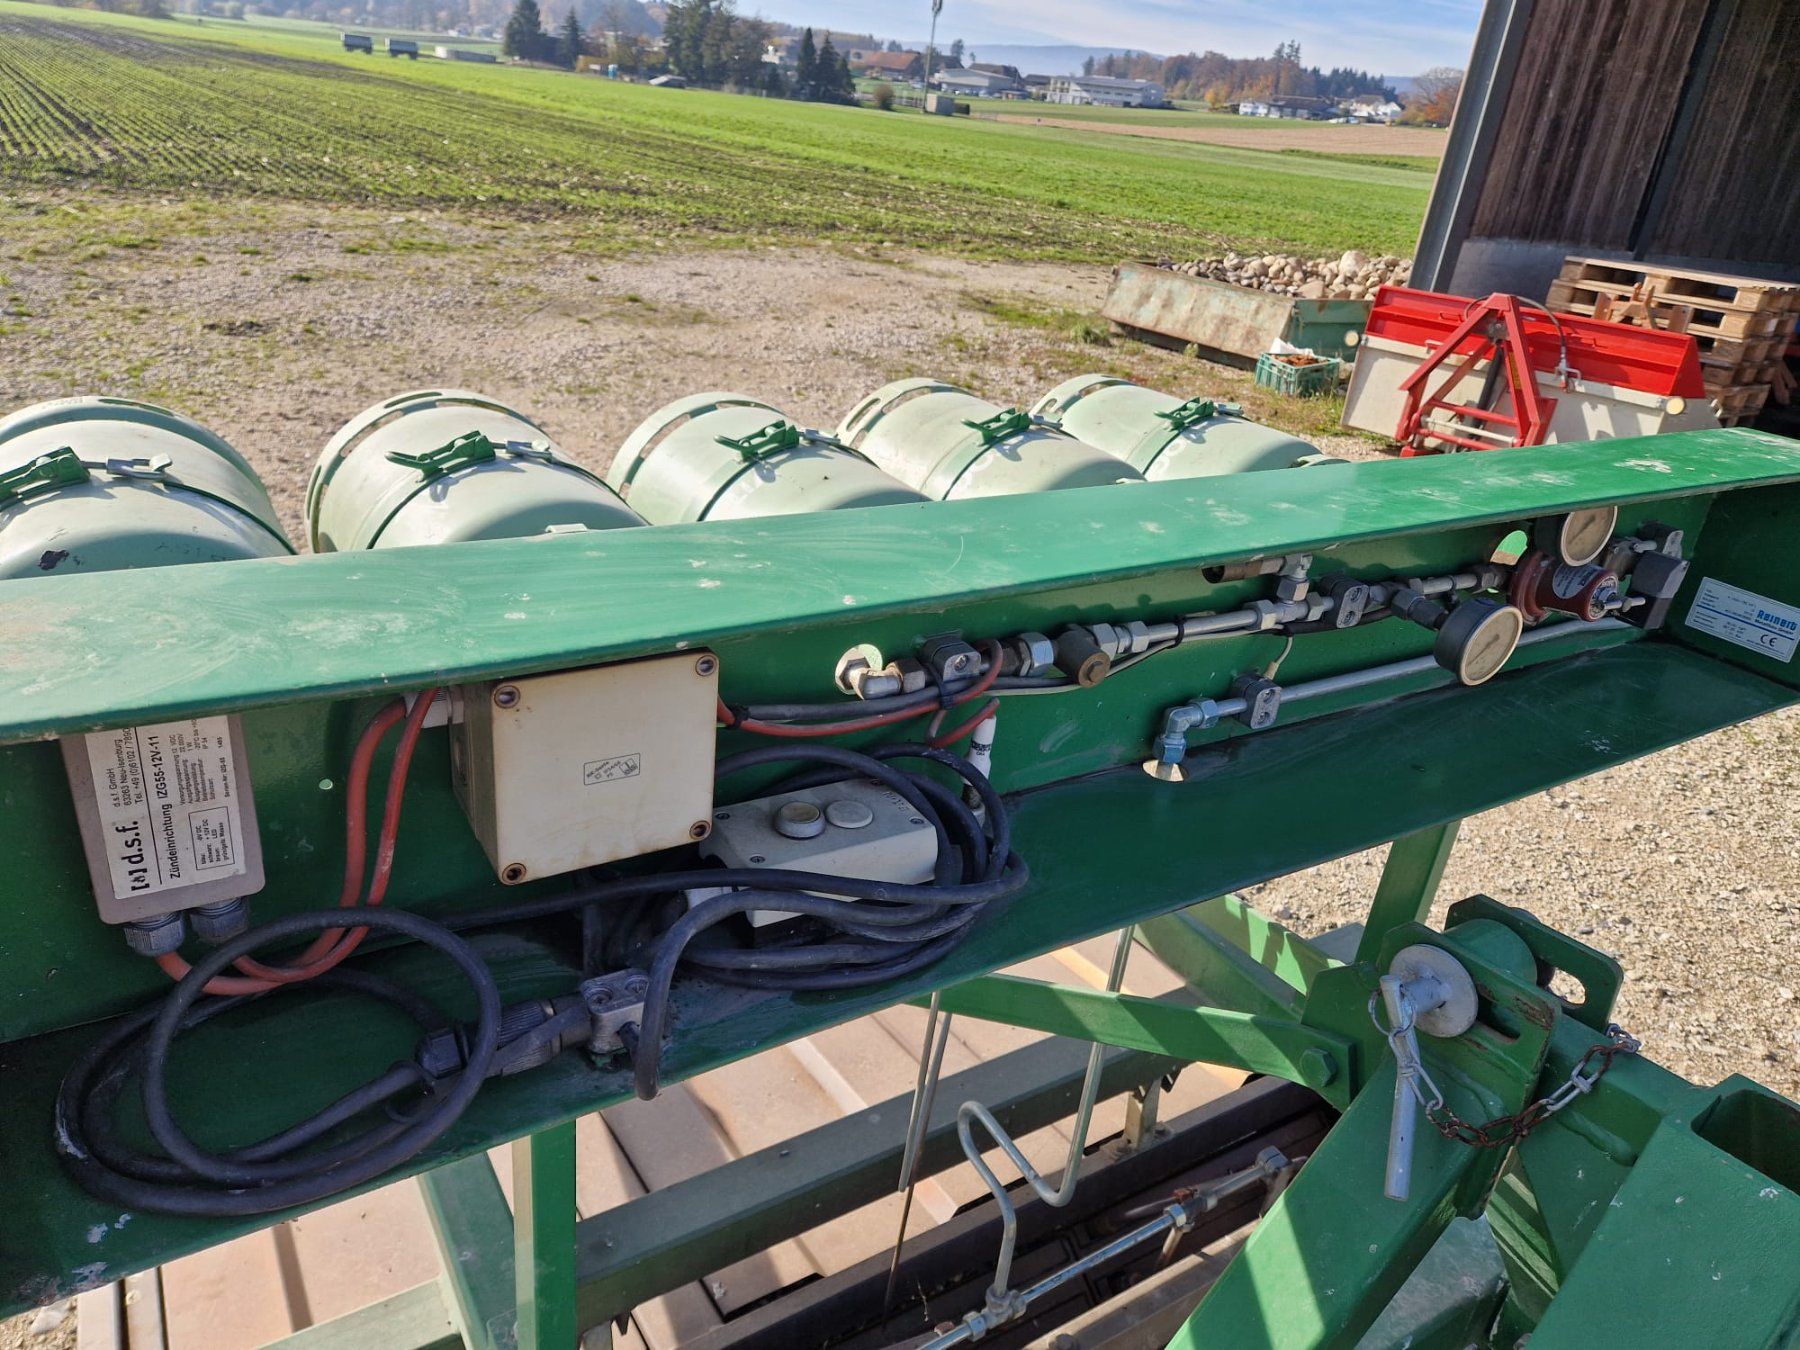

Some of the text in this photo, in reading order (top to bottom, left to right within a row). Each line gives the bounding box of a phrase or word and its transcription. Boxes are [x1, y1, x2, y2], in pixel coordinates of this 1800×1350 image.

[1757, 610, 1798, 631] Reinert
[114, 739, 132, 806] 63263 Neu-Isenburg
[126, 751, 140, 776] (0)6102
[147, 736, 168, 799] IZG55-12V-11
[106, 768, 117, 790] GmbH
[131, 777, 140, 789] +49
[195, 825, 202, 833] DC
[202, 819, 209, 827] DC
[115, 821, 144, 865] d.s.f.
[161, 803, 181, 879] Zündeinrichtung
